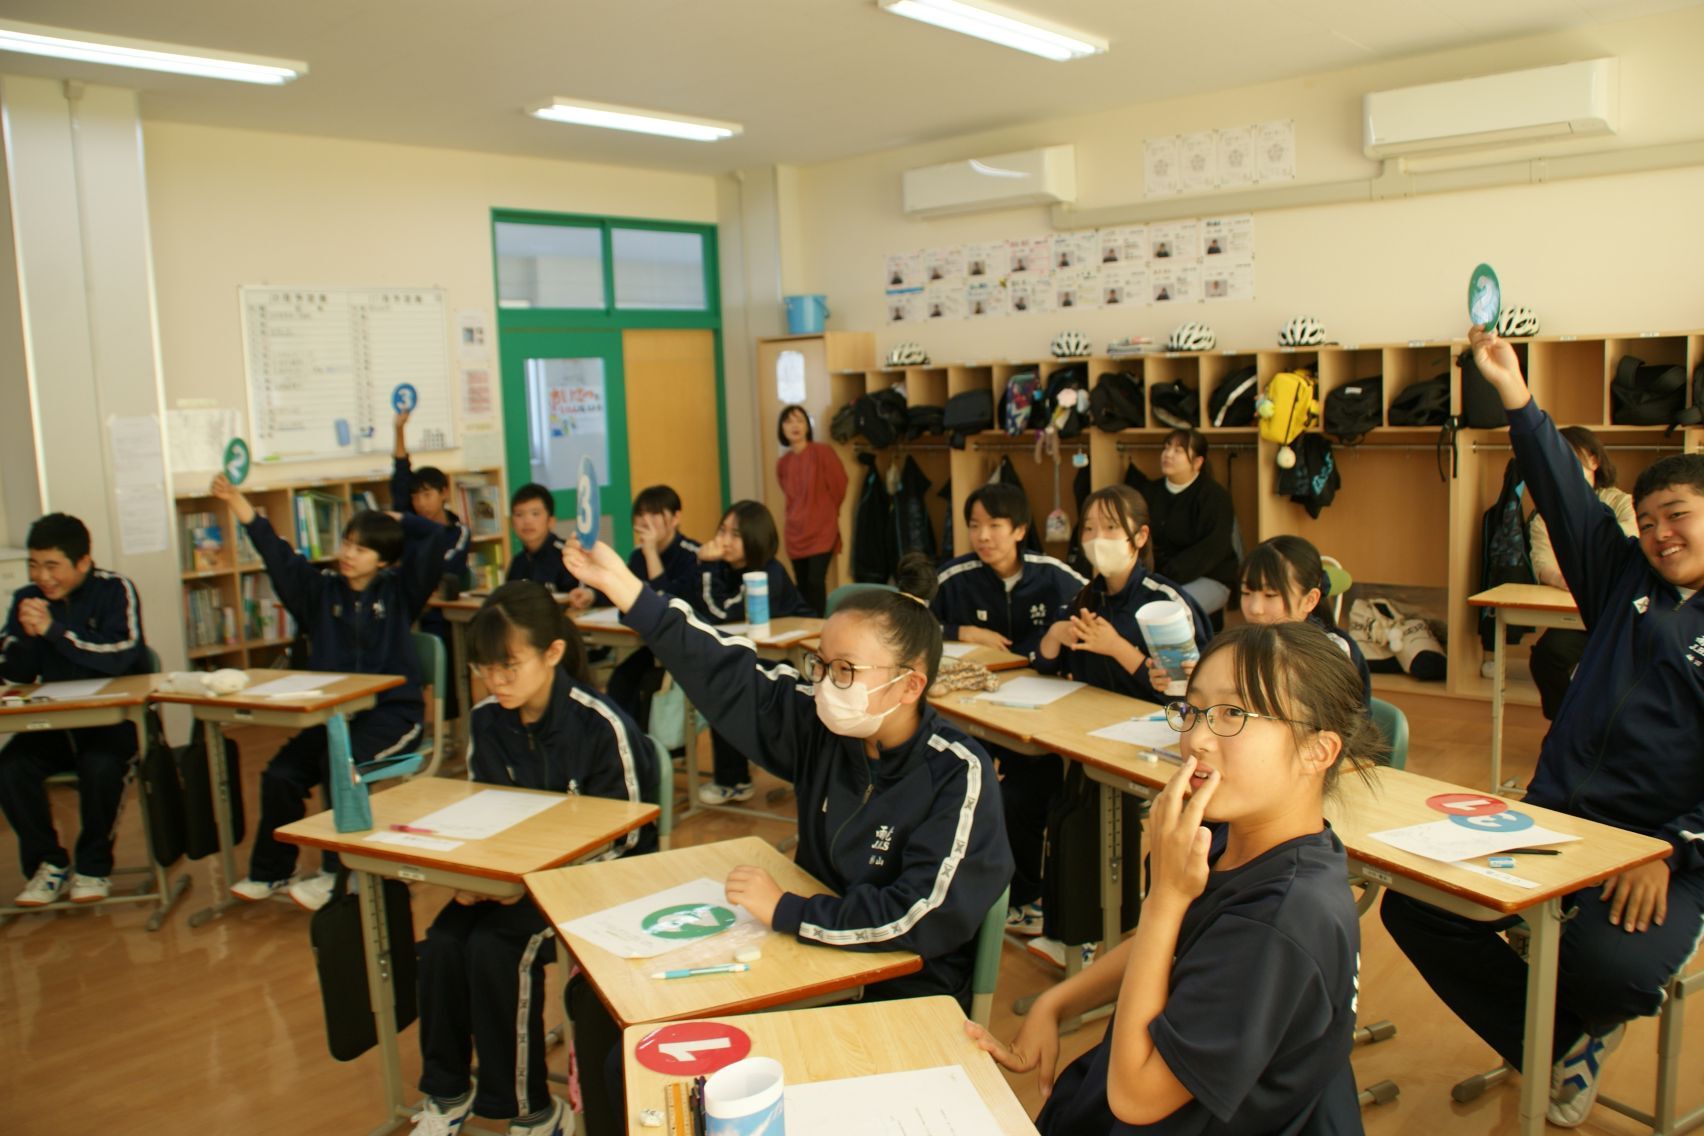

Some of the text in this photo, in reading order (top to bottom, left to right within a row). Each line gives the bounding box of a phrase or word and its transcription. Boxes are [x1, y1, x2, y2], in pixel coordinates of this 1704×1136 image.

[397, 388, 412, 412] 3
[227, 445, 247, 480] 2
[577, 474, 593, 534] 3
[1442, 800, 1491, 811] 1
[658, 1037, 732, 1062] 1
